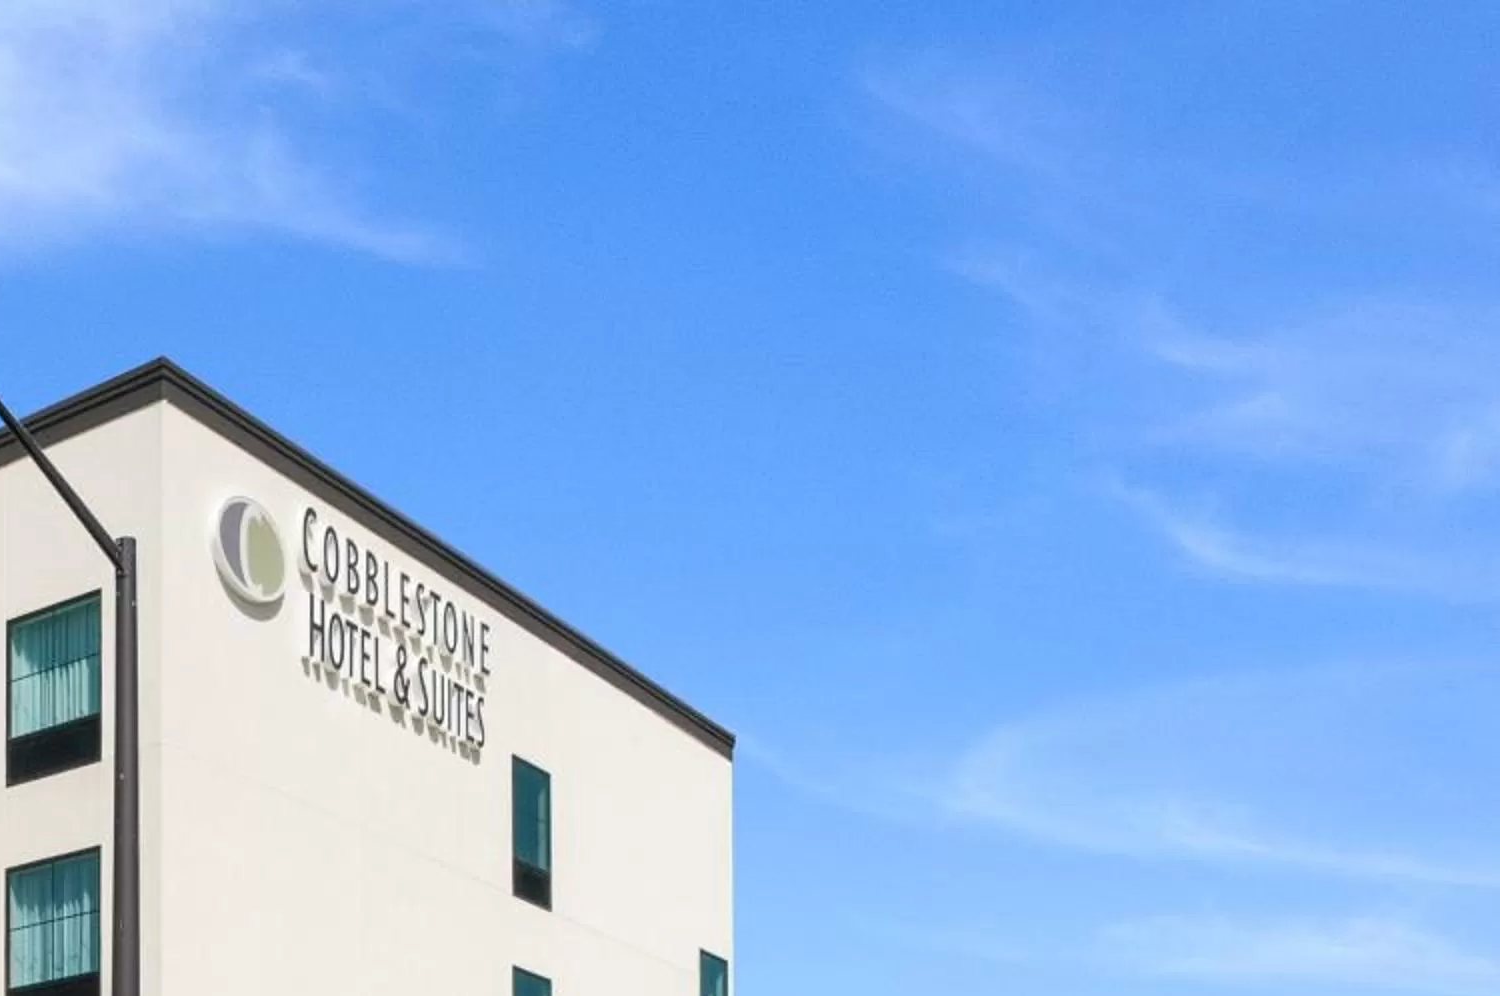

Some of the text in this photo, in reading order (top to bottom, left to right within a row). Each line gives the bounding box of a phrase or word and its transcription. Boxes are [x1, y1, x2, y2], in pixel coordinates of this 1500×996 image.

[303, 507, 491, 676] COBBLESTONE
[309, 592, 486, 749] HOTEL & SUITES
